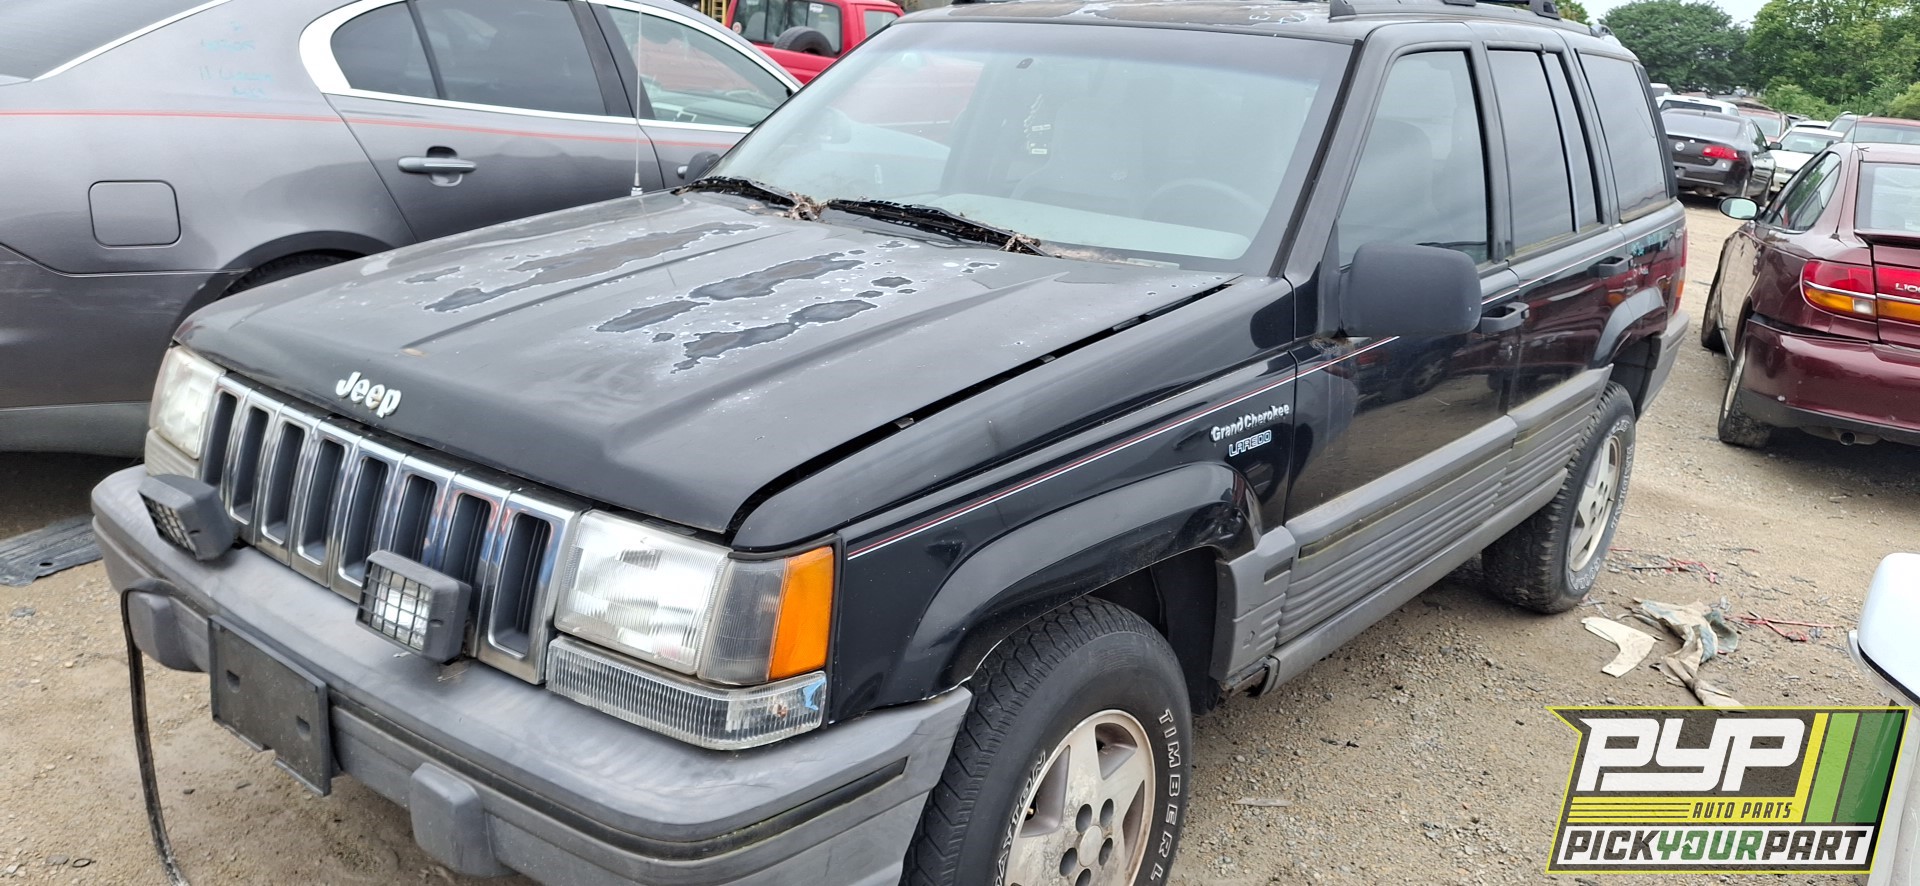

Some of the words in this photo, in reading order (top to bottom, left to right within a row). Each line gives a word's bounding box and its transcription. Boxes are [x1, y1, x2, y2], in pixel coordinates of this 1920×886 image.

[335, 371, 402, 419] Jeep
[1210, 416, 1243, 442] Grand
[1244, 404, 1290, 429] Cherokee
[1228, 429, 1272, 457] LAREDO
